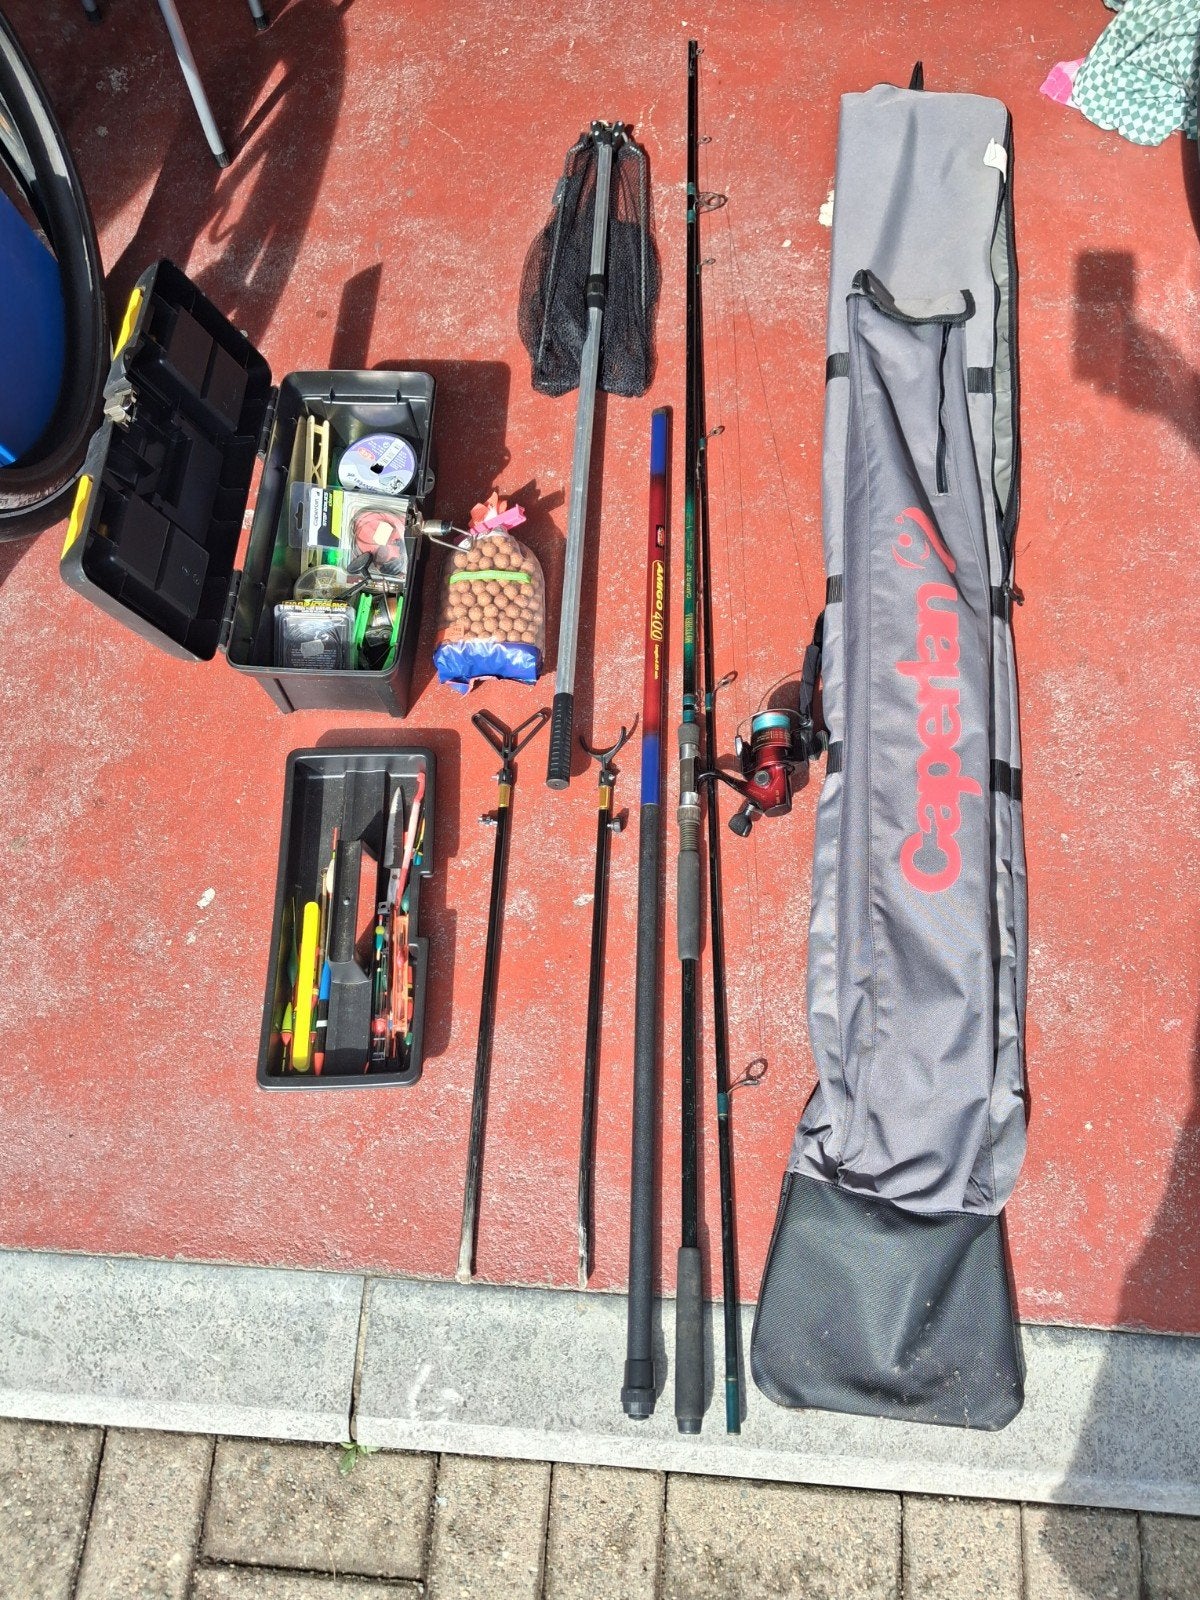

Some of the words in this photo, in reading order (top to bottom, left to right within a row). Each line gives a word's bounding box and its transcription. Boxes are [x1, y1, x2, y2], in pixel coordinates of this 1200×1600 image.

[656, 562, 664, 610] AMIGO
[652, 611, 663, 640] 400
[895, 582, 982, 893] Caperlan
